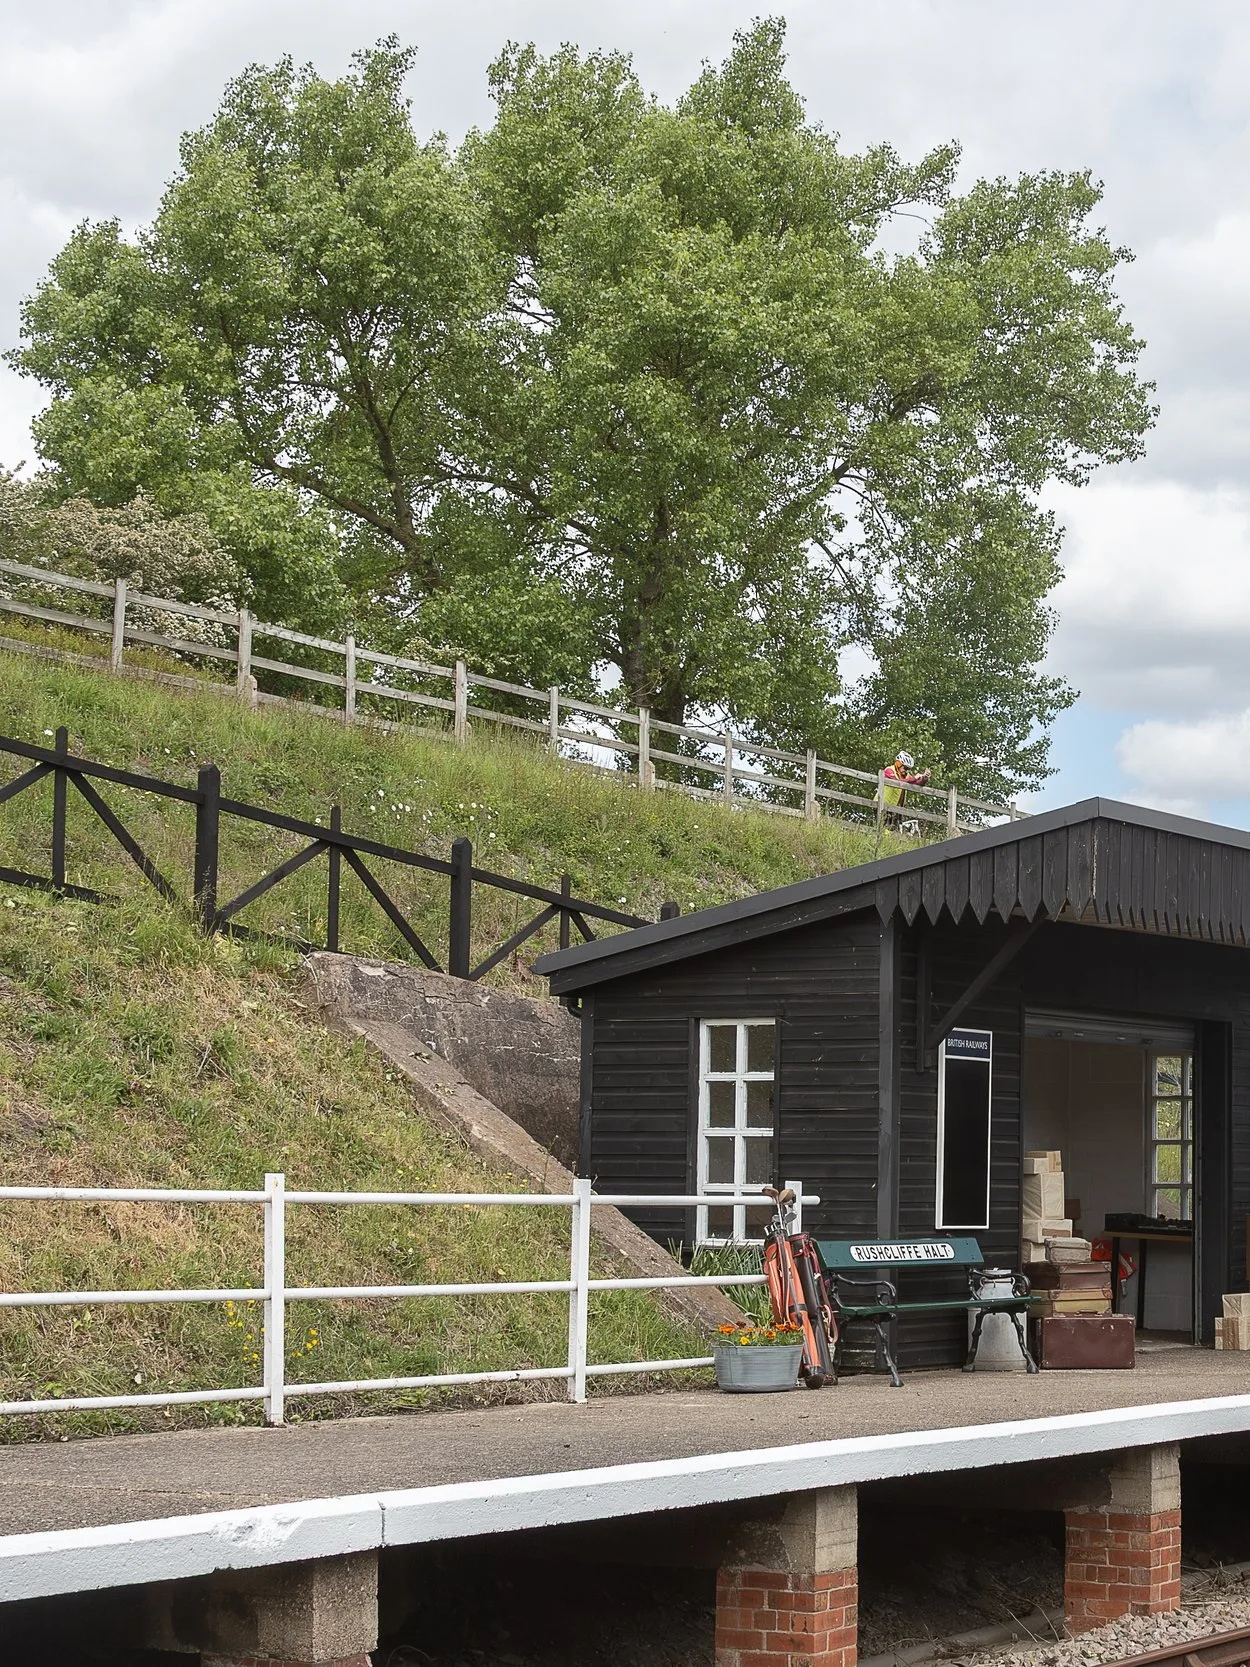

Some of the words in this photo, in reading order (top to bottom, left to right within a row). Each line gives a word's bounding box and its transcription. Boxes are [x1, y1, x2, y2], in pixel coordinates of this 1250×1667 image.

[947, 1038, 965, 1048] BRITISH
[966, 1040, 988, 1050] RAILWAYS
[855, 1245, 921, 1260] RUSHCLIFFE
[923, 1244, 949, 1258] HALT
